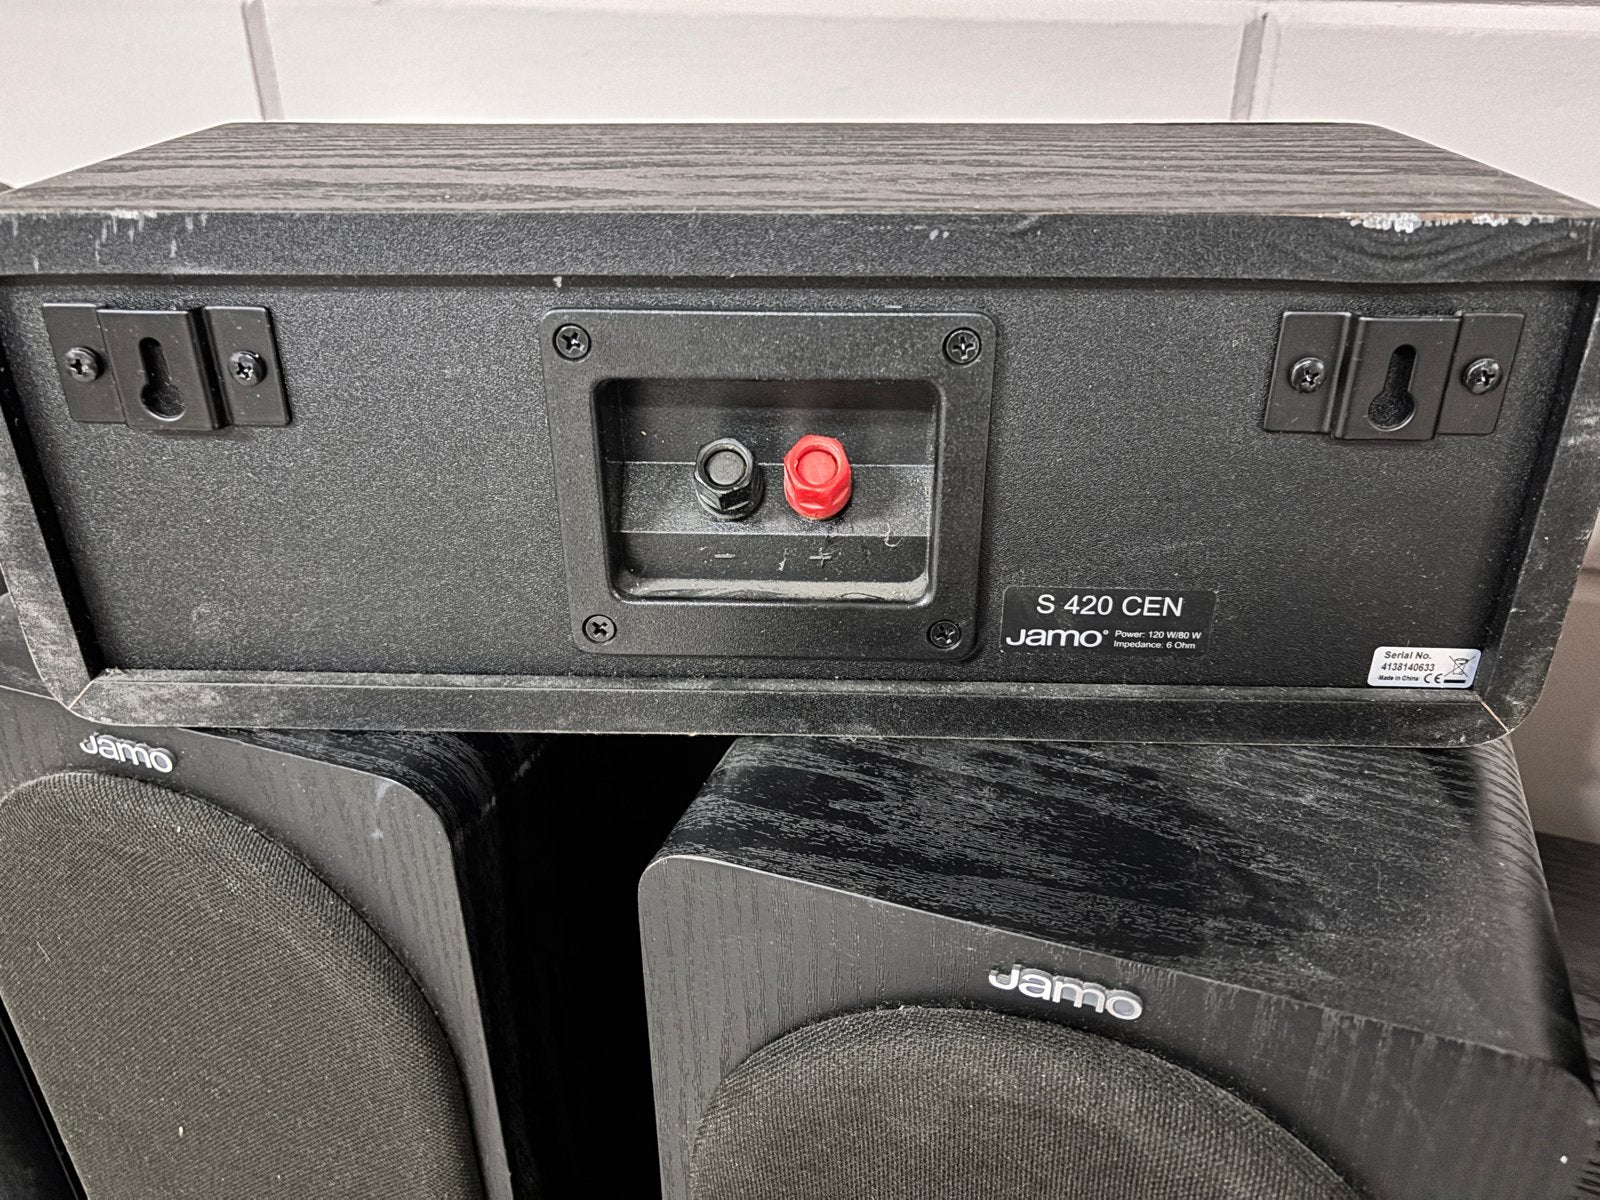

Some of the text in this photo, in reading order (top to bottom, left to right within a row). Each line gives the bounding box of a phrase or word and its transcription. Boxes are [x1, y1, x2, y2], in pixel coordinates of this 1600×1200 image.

[1036, 593, 1184, 617] S 420 CEN
[1114, 629, 1202, 640] Power: 120 W/80 W
[1113, 639, 1196, 650] Impedance: 6 Ohm
[1384, 650, 1432, 660] Serial No.
[1381, 662, 1436, 672] 4138140633
[1401, 674, 1420, 682] China
[79, 733, 174, 773] Jamo
[988, 965, 1143, 1021] Jamo
